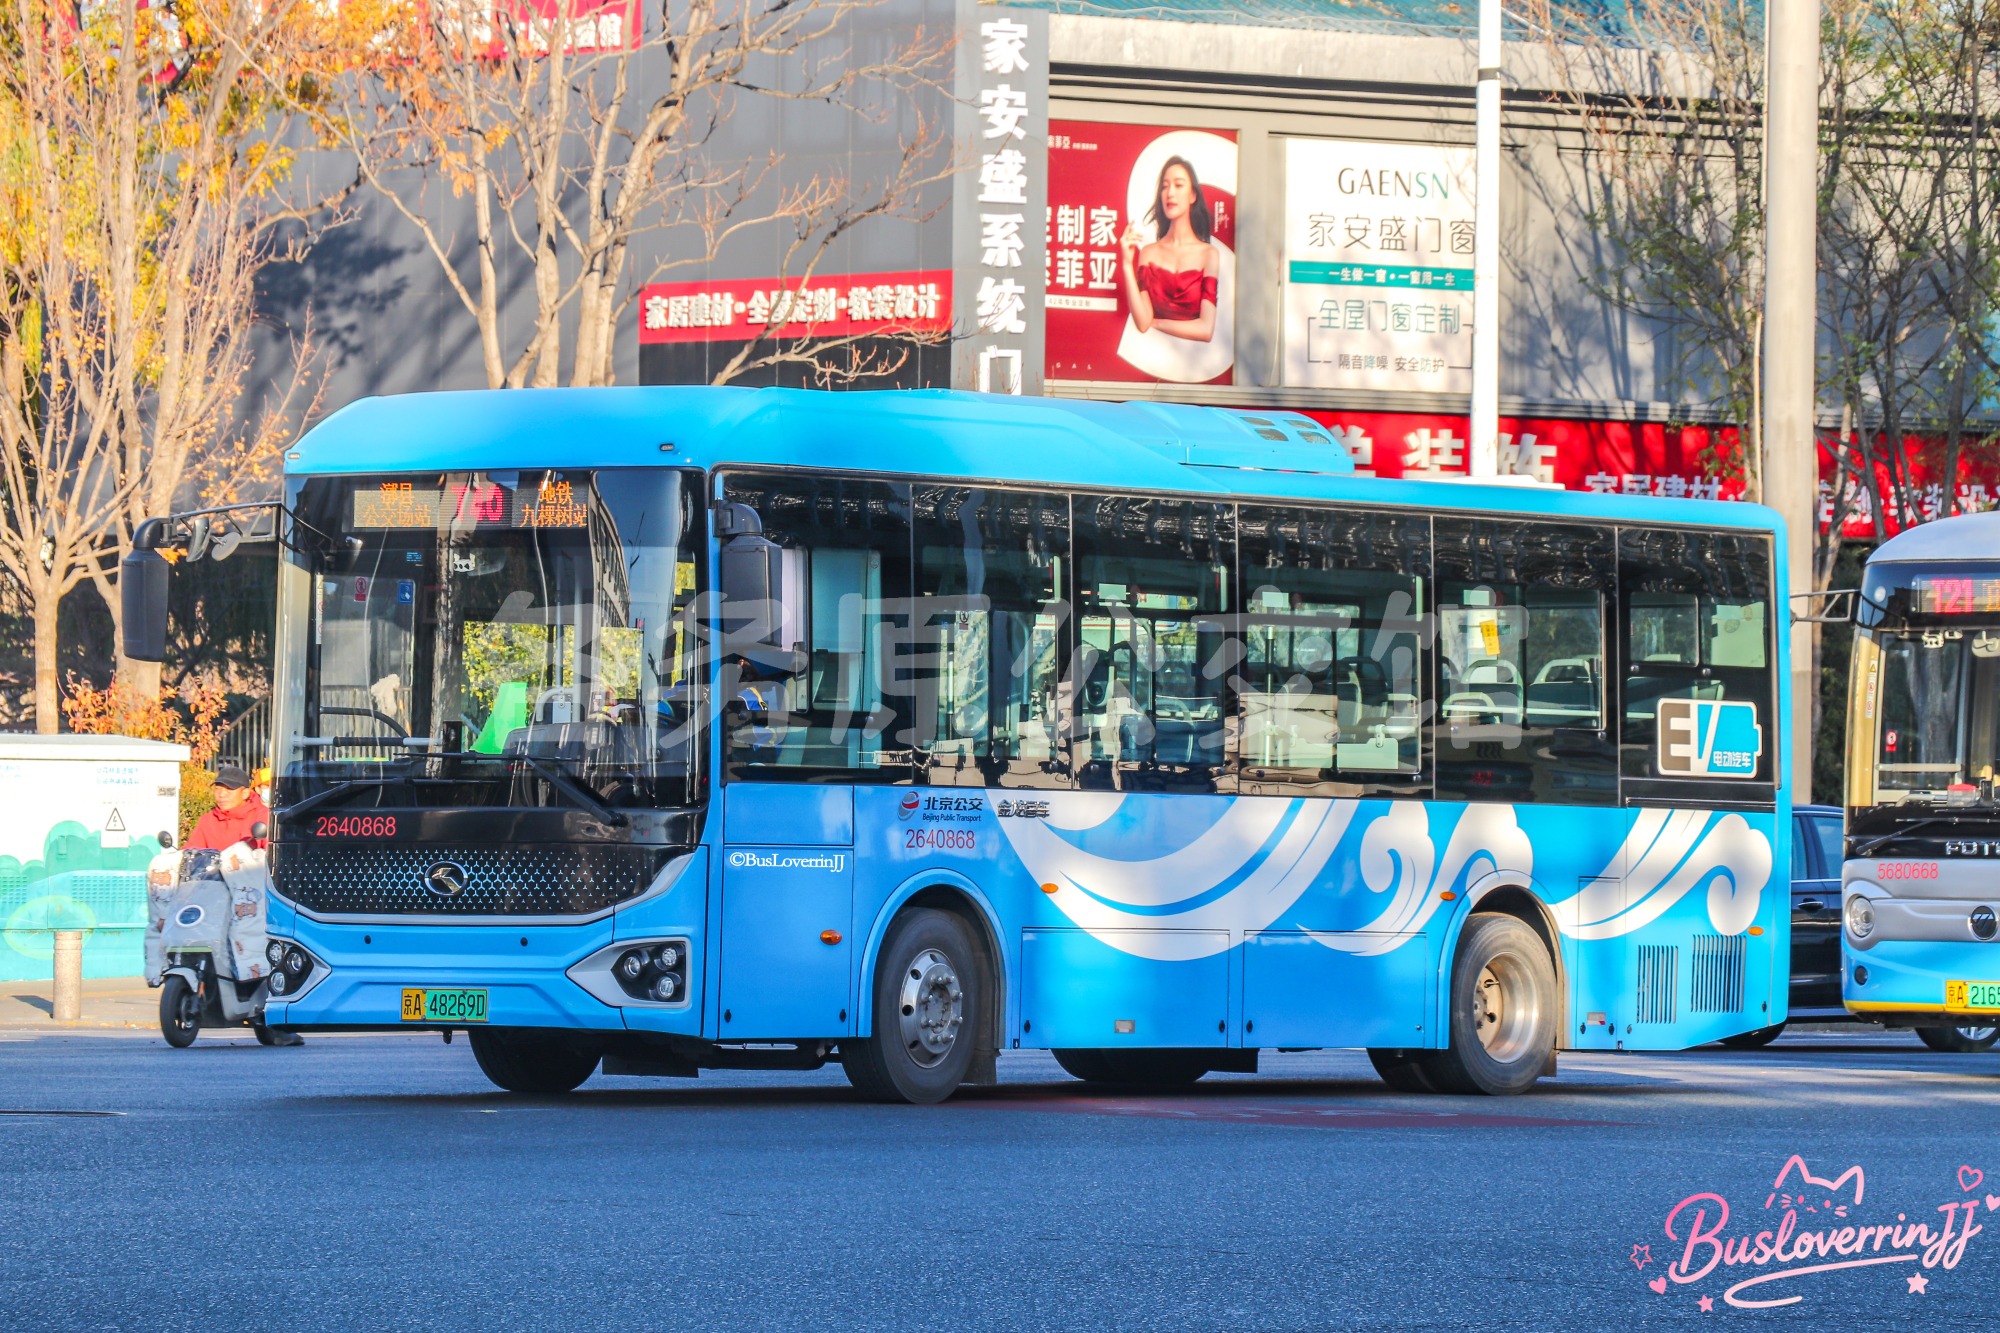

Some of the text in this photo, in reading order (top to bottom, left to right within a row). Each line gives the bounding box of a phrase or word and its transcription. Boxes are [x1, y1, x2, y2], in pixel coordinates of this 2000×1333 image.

[1308, 212, 1475, 254] 家安盛门窗
[1046, 249, 1117, 290] 菲亚
[1319, 299, 1460, 335] 全屋门窗定制
[1338, 354, 1445, 373] 隔音降噪 安全防护
[538, 481, 573, 504] 地铁
[520, 503, 587, 527] 九棵树站
[1931, 578, 1973, 614] T21
[1713, 751, 1751, 767] 电动汽车
[923, 797, 983, 811] 北京公交
[316, 816, 396, 836] 2640868
[922, 813, 981, 823] Beijing Public Transport
[905, 829, 975, 849] 2640868
[1877, 862, 1939, 880] 5680668
